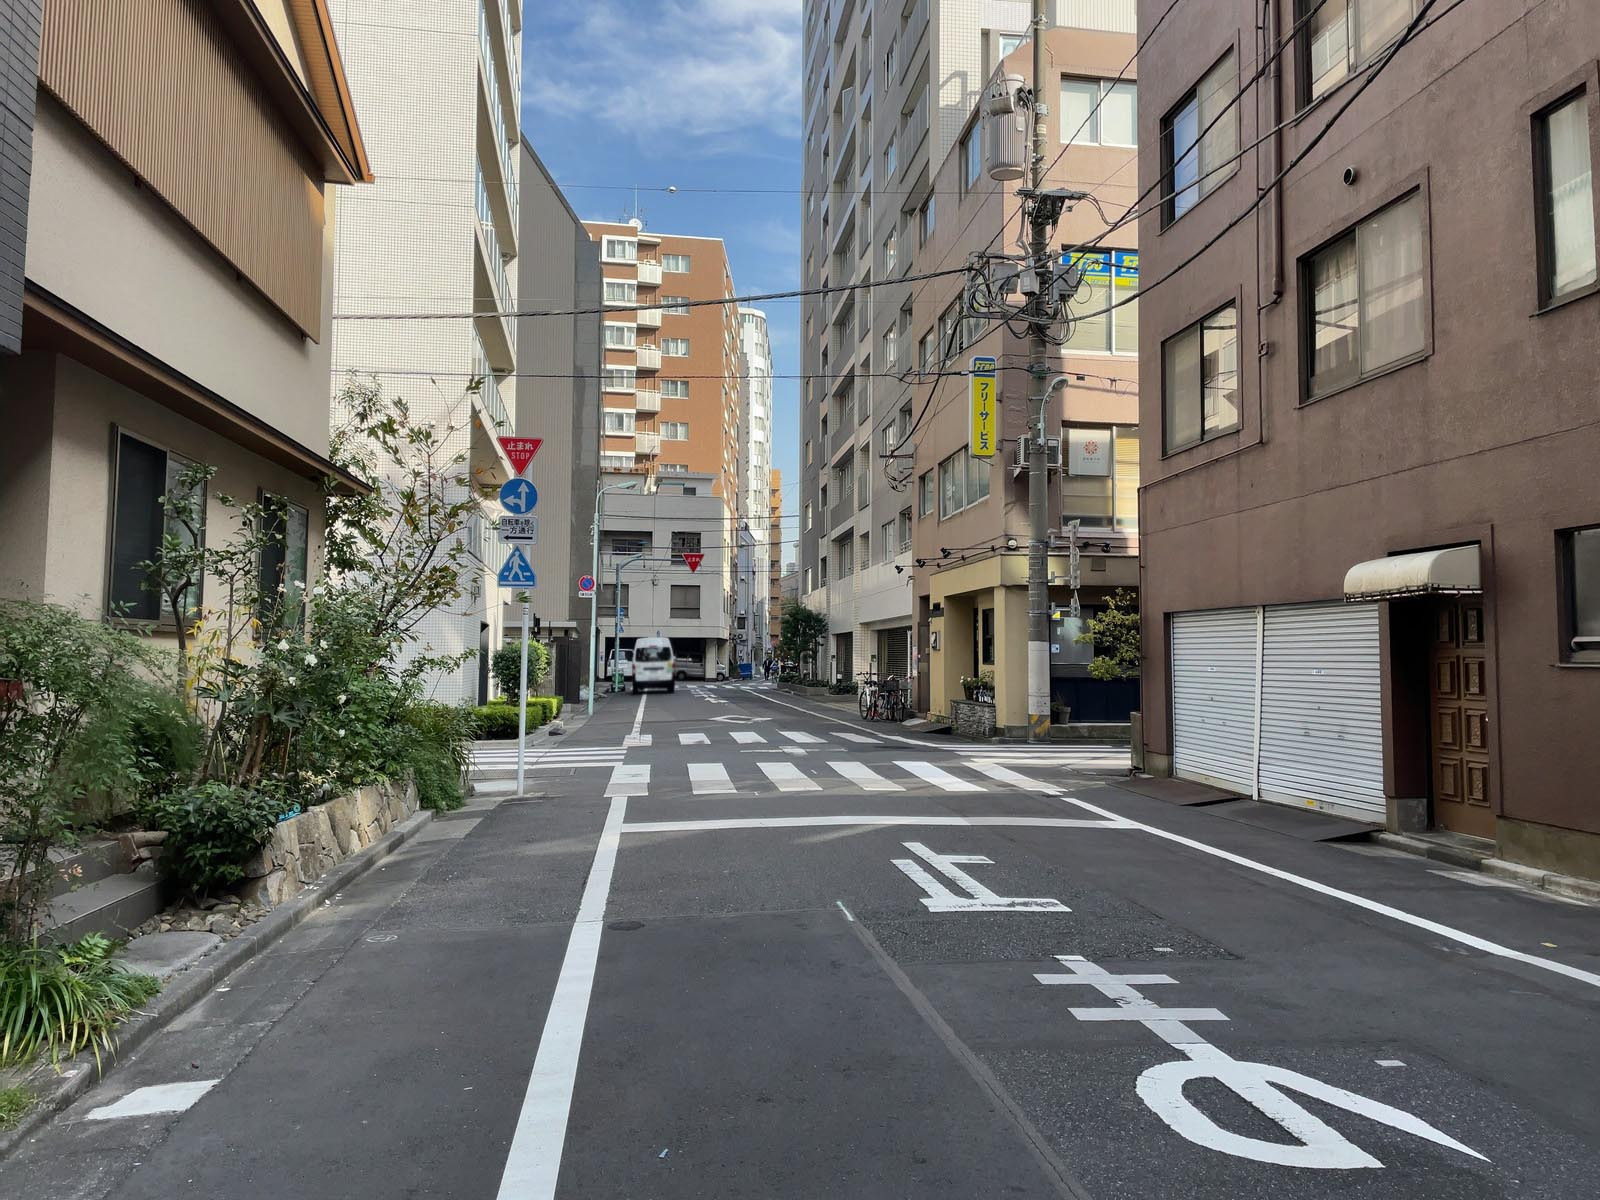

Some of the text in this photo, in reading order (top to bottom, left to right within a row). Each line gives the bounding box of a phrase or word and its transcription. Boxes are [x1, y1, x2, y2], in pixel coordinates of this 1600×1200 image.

[979, 382, 989, 450] フリーサービス
[506, 441, 534, 451] 止まれ
[511, 451, 530, 460] STOP
[501, 526, 534, 535] 一方通行
